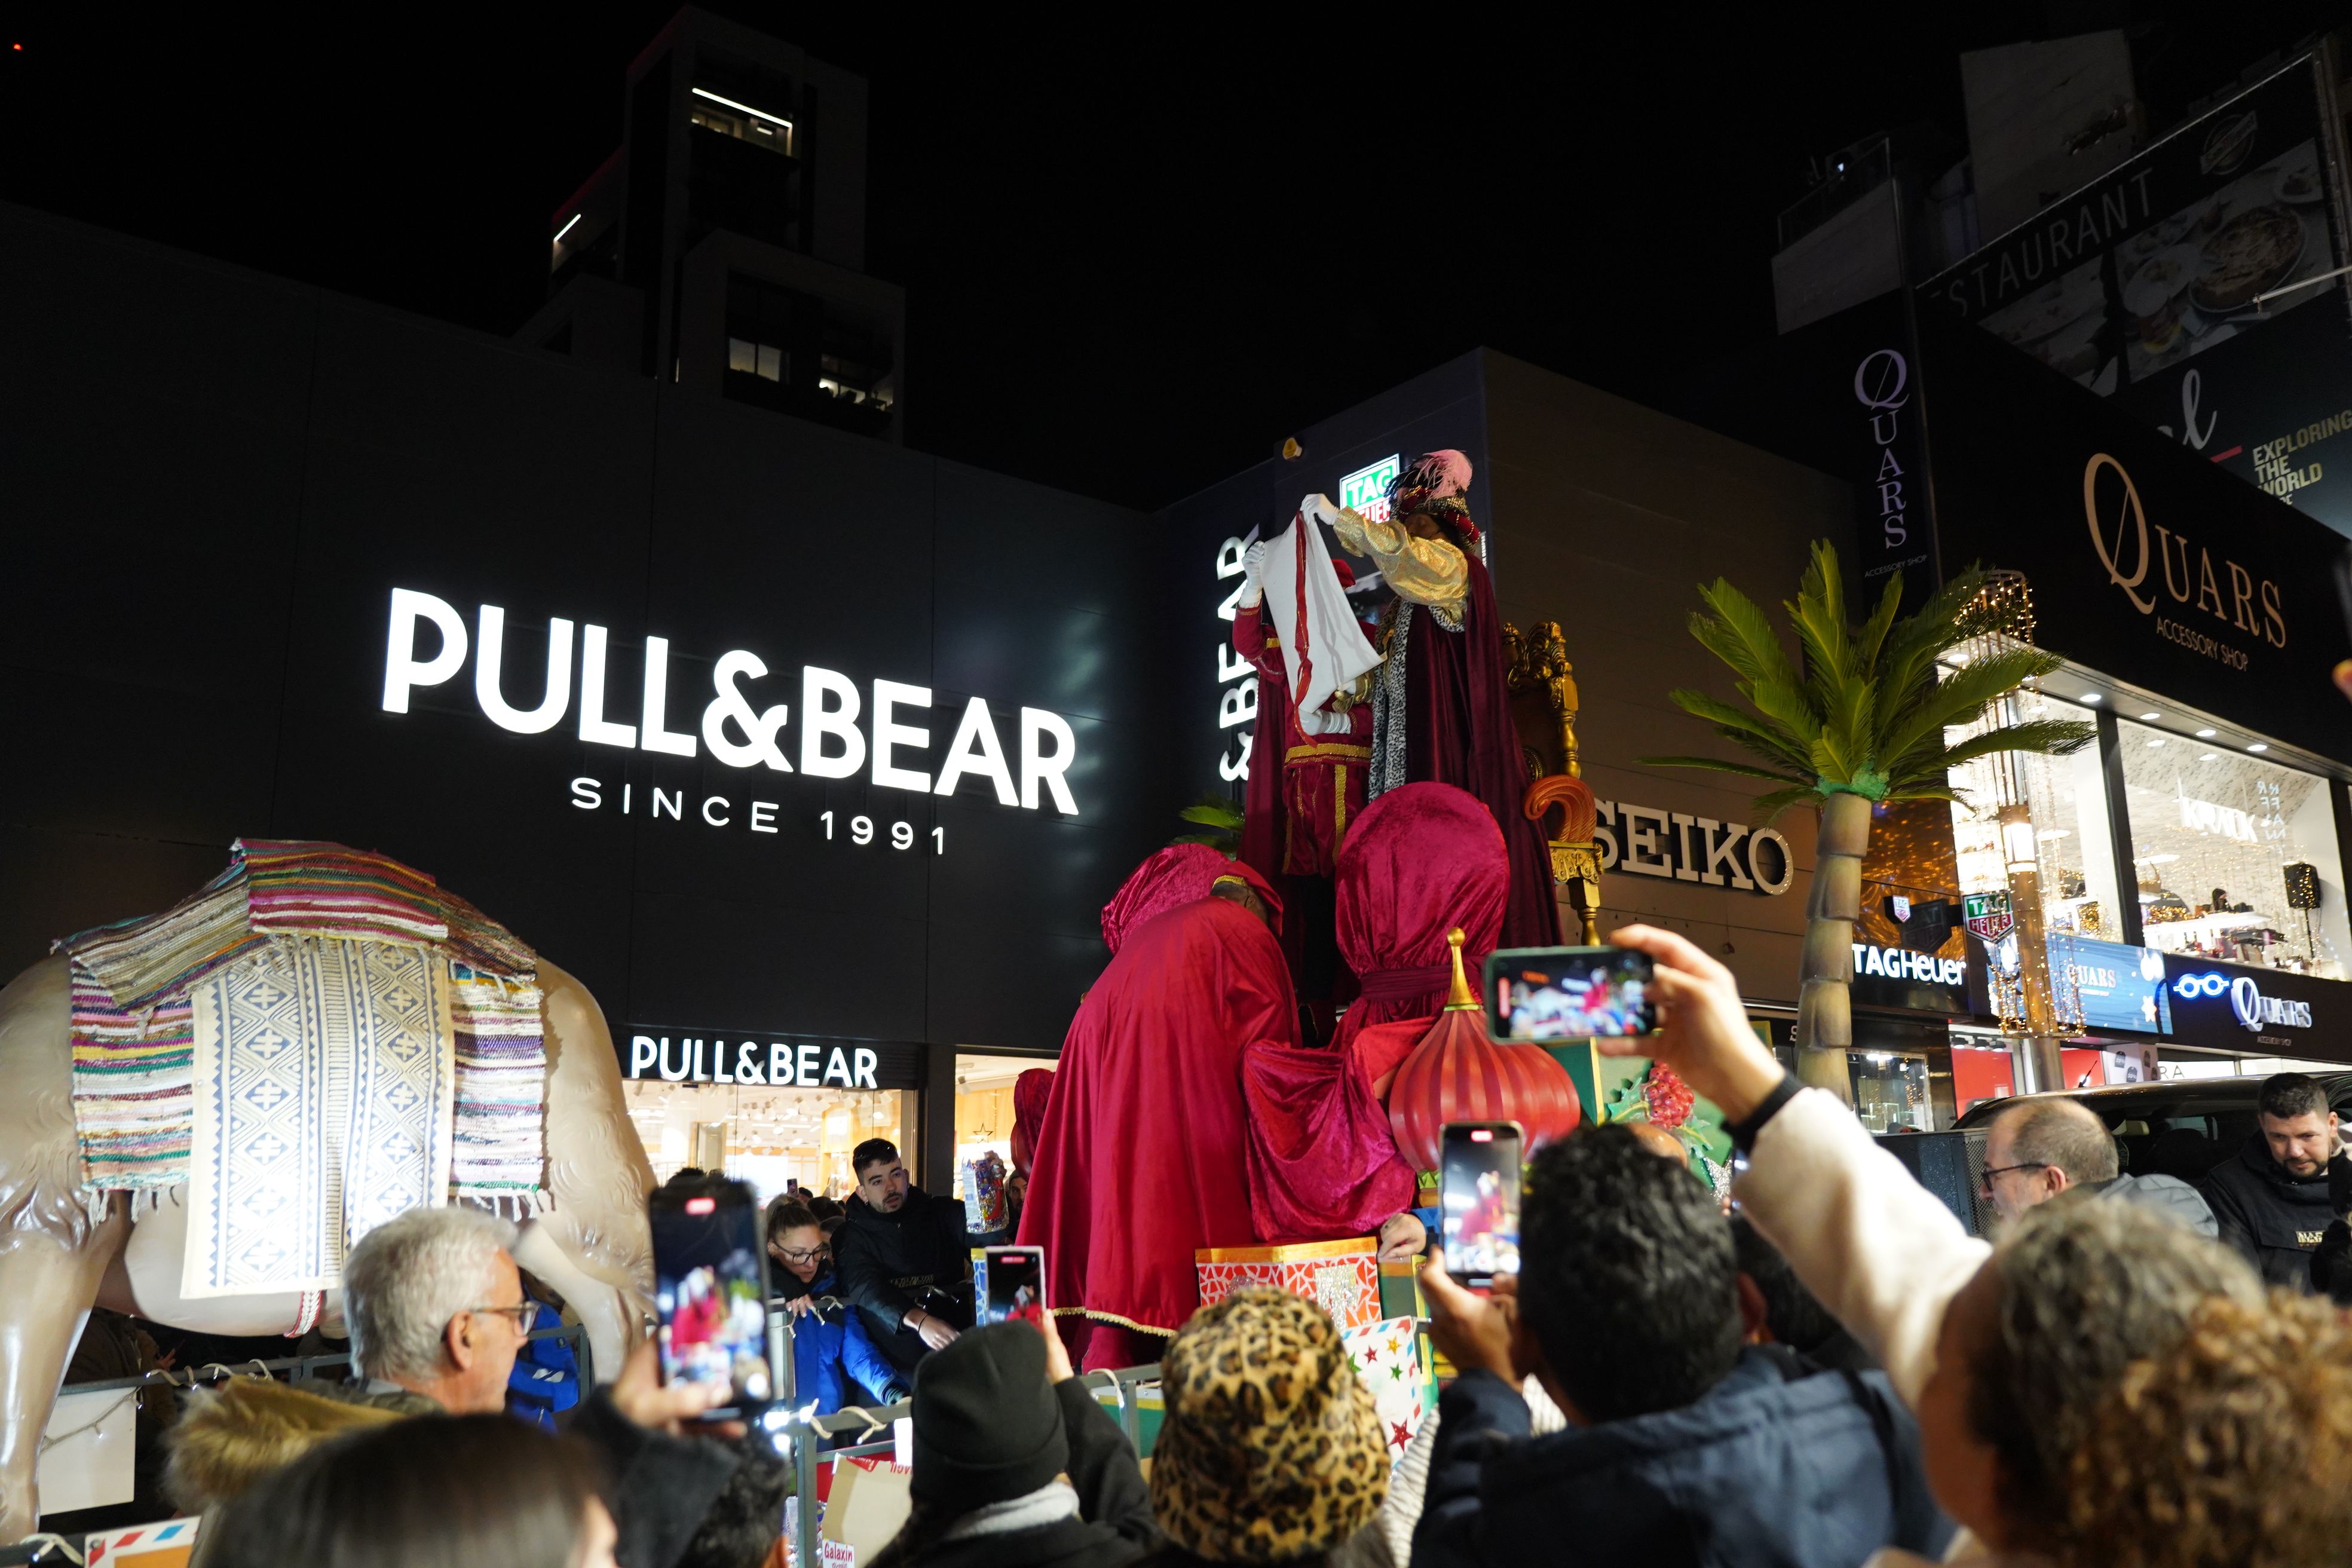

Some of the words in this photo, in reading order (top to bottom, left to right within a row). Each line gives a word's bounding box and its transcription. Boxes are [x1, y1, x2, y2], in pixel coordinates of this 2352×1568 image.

[1928, 167, 2153, 318] STAURANT
[1854, 348, 1910, 549] QUARS
[2254, 455, 2292, 483] THE
[1347, 468, 1392, 507] TAG
[2083, 452, 2286, 648] QUARS
[2156, 615, 2218, 660] ACCESSORY
[2221, 644, 2249, 672] SHOP
[382, 587, 1079, 816] PULL&BEAR
[571, 777, 779, 834] SINCE
[820, 811, 944, 856] 1991
[1968, 892, 2008, 915] TAG
[2231, 976, 2313, 1033] QUARS
[631, 1036, 878, 1089] PULL&BEAR
[824, 1542, 853, 1562] Galaxin
